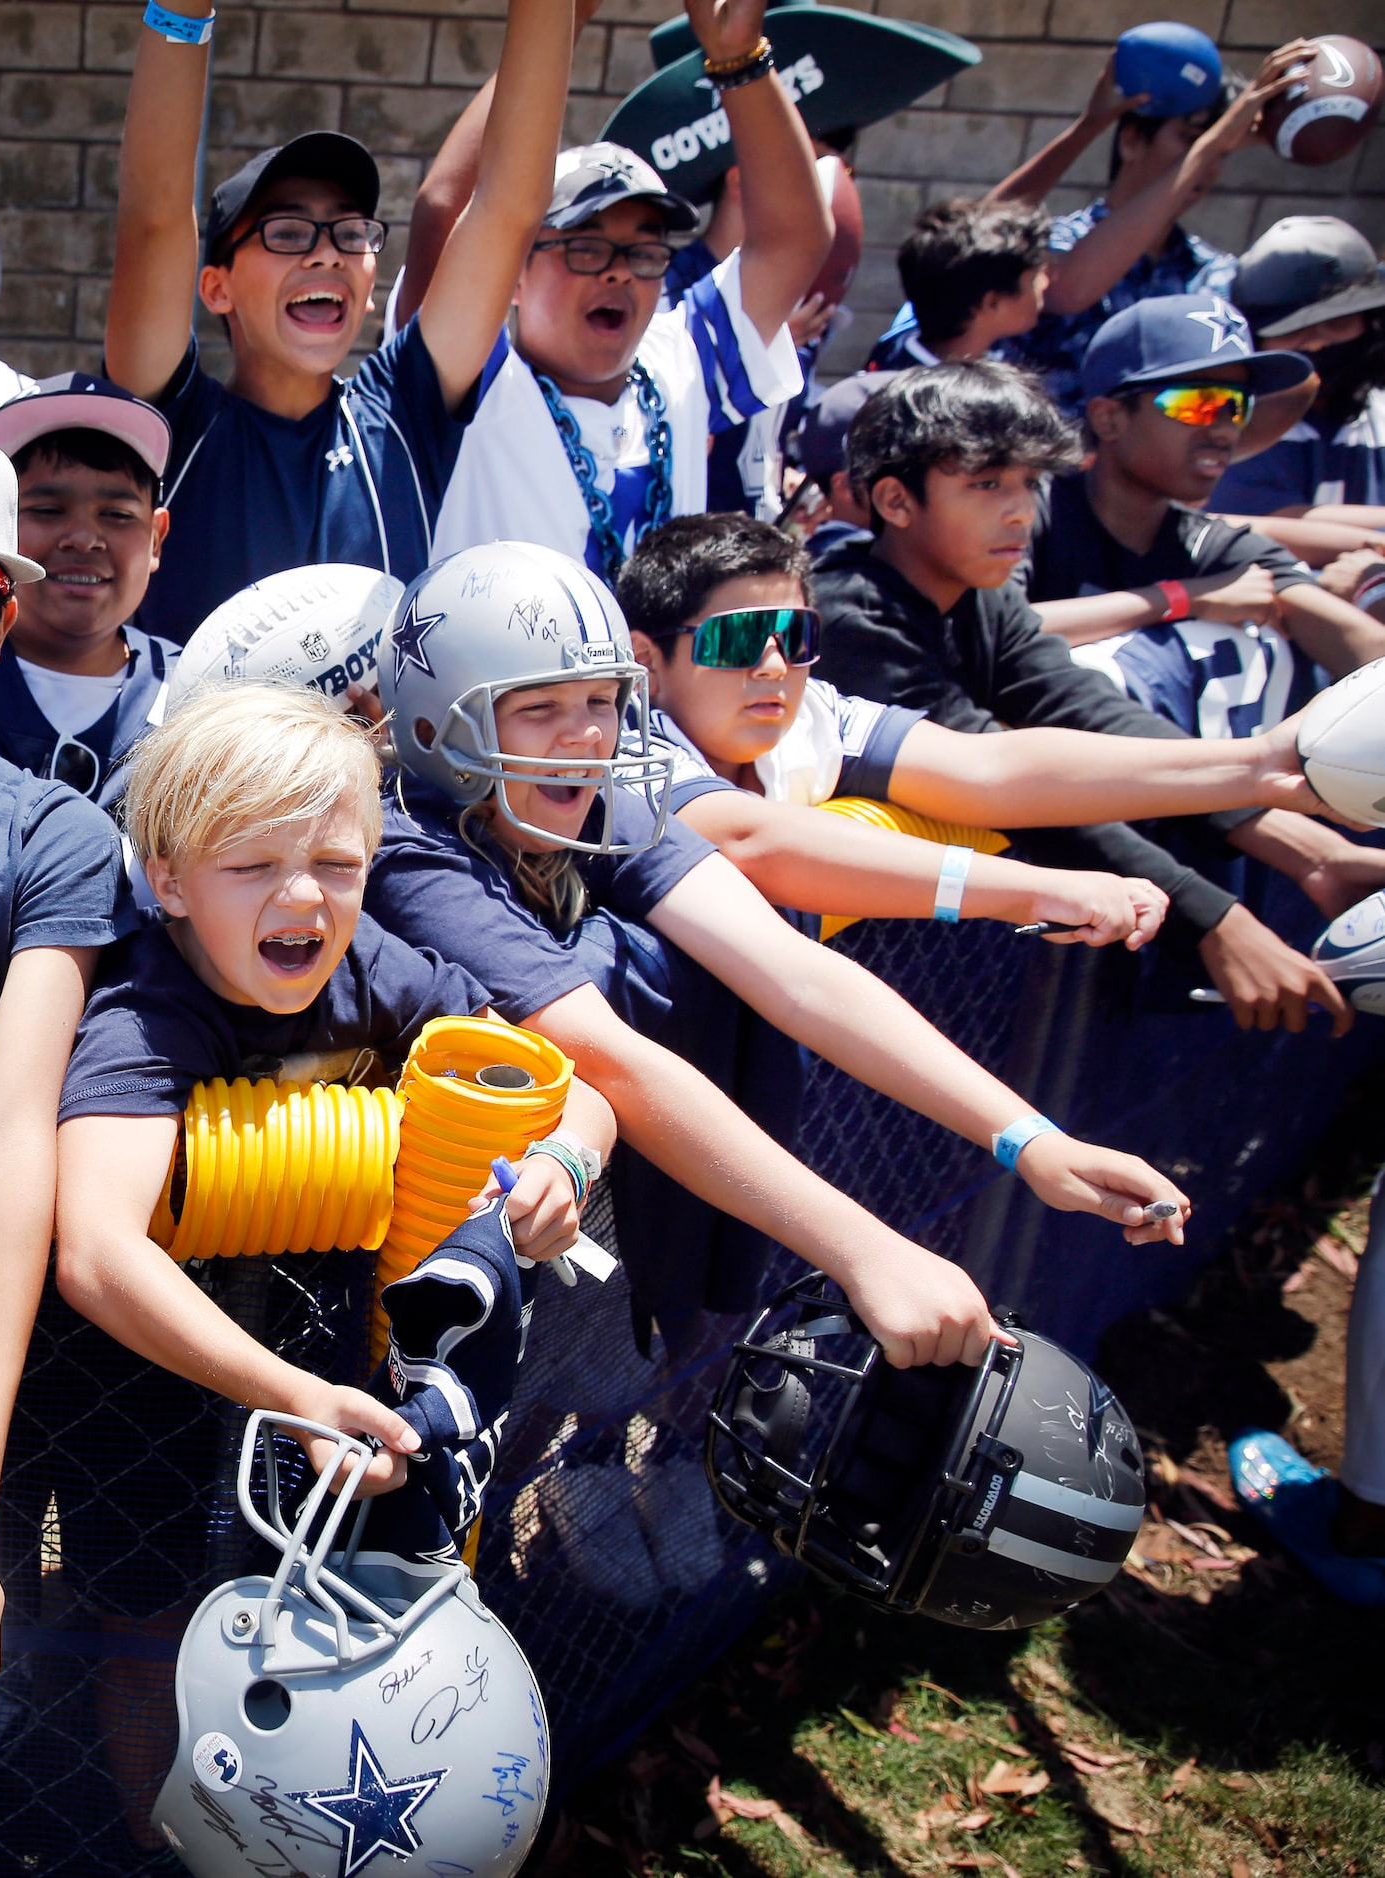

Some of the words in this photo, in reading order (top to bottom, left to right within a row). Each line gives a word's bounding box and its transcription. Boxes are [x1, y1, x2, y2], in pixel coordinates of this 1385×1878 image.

[651, 54, 825, 170] COWYS
[308, 641, 328, 660] NFL
[586, 645, 615, 659] Franklin
[972, 1474, 1004, 1530] COWBOYS
